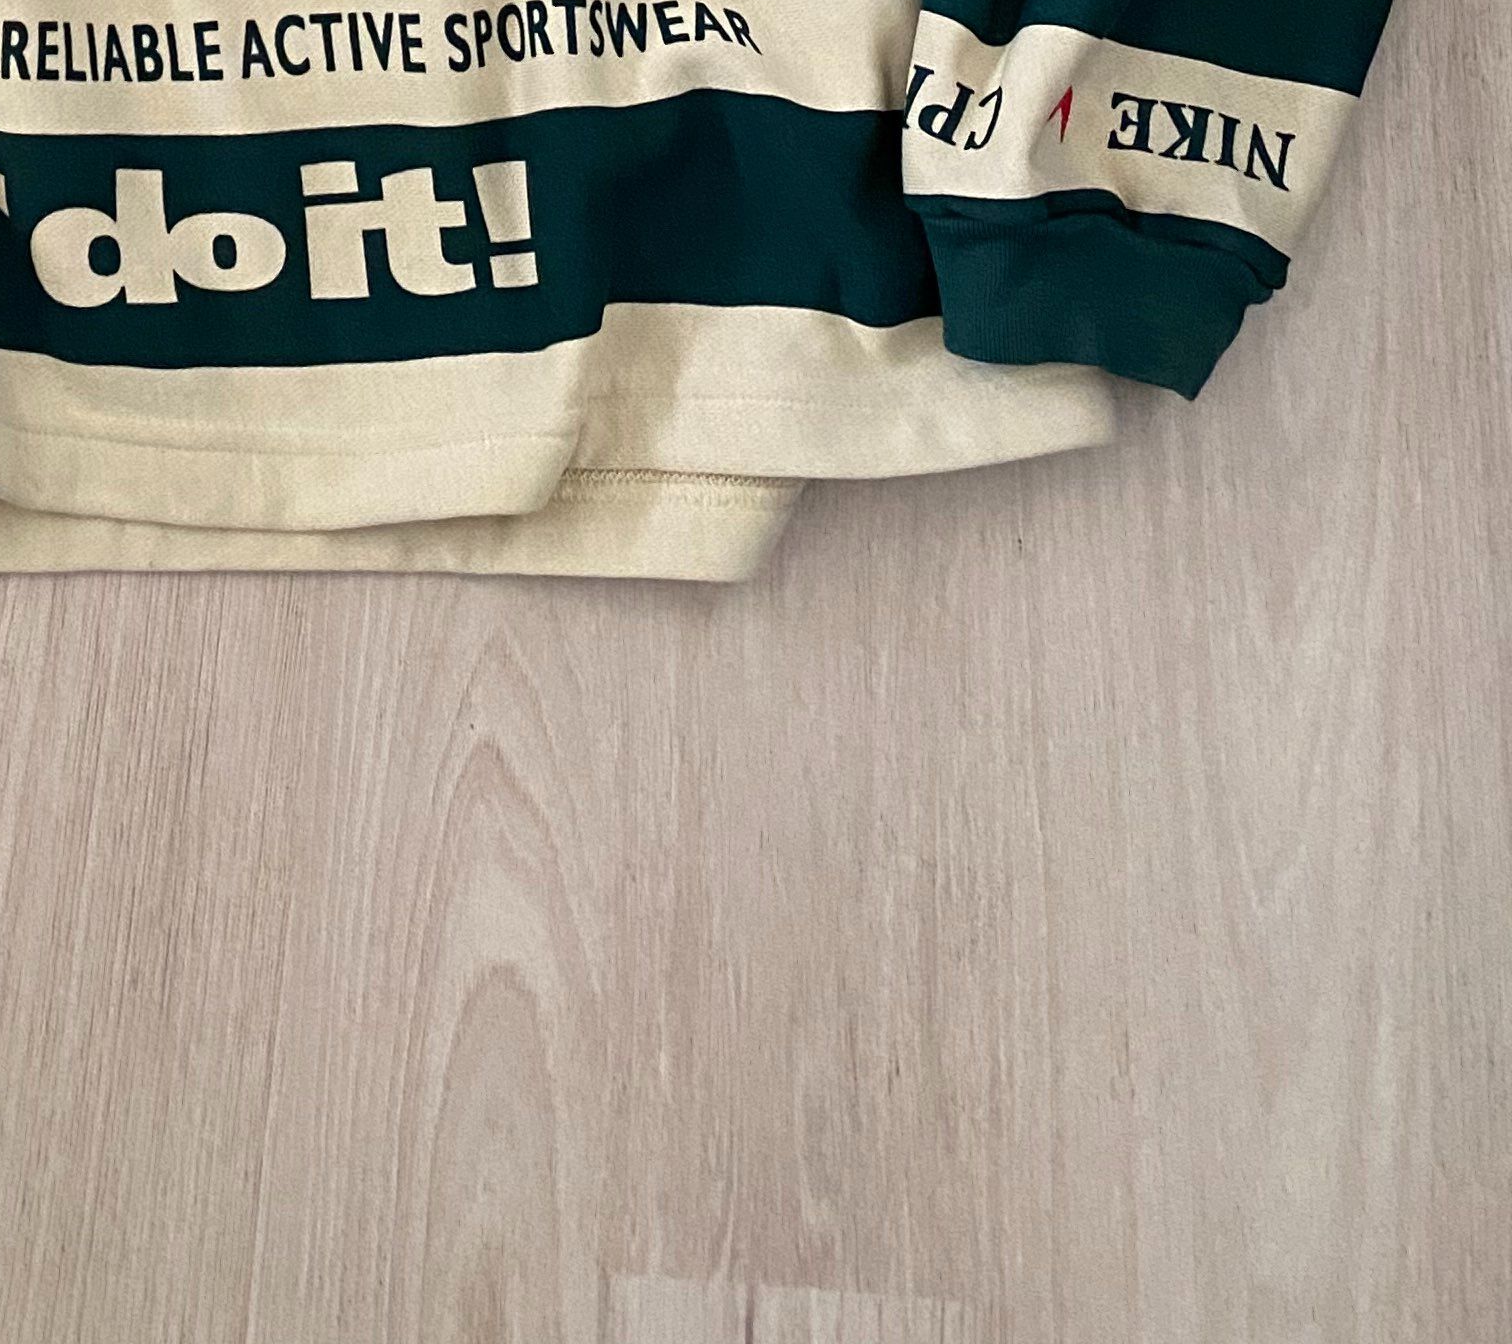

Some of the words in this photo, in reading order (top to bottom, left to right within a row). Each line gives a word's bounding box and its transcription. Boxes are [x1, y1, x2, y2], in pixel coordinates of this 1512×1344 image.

[1, 18, 225, 82] RELIABLE
[240, 11, 427, 79] ACTIVE
[1107, 91, 1296, 192] NIKE
[29, 167, 287, 309] do
[298, 159, 539, 300] it!
